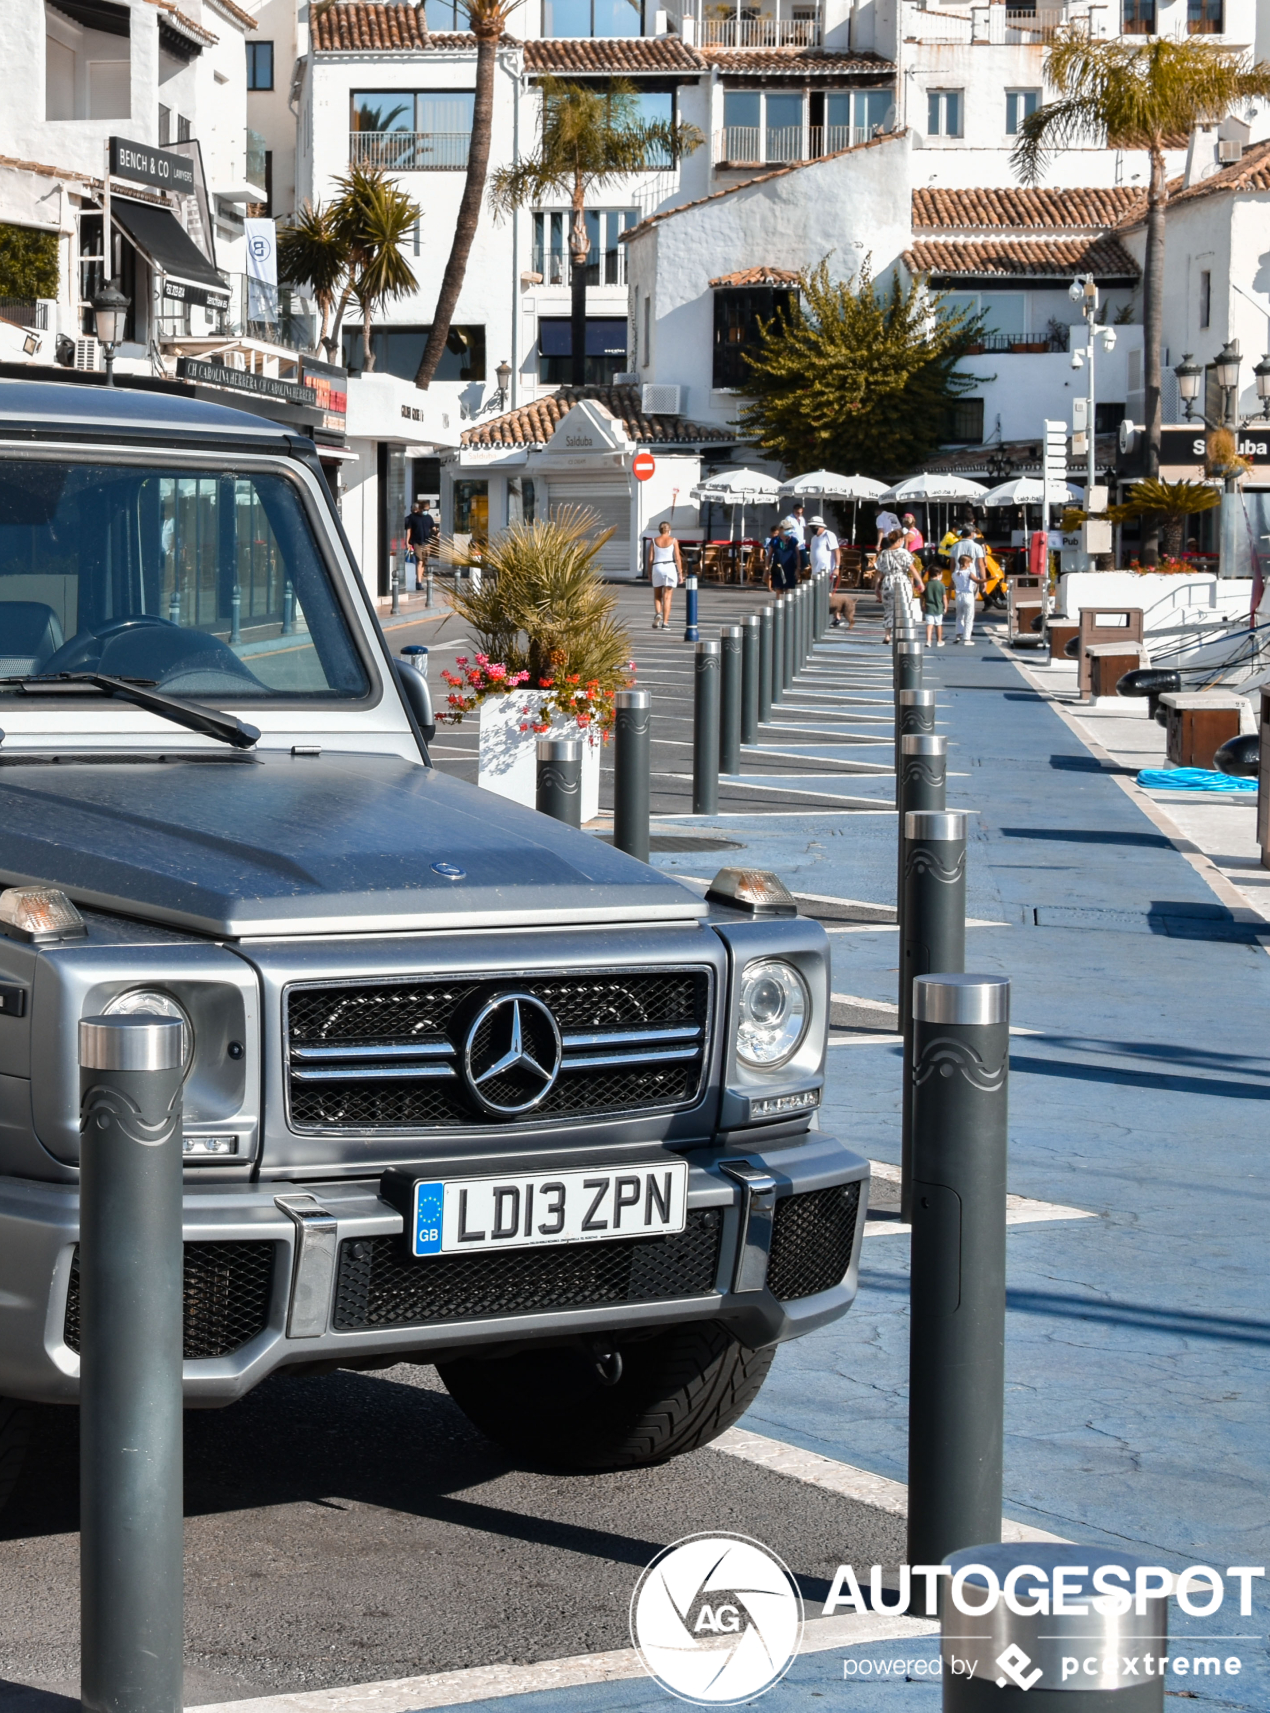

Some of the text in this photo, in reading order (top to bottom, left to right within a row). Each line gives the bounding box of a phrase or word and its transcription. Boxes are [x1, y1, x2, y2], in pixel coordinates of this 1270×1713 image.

[119, 148, 193, 183] BENCH & CO LAWYERS
[187, 362, 197, 376] CH
[198, 363, 230, 384] CAROLINA
[229, 371, 257, 391] HERRERA
[566, 436, 593, 447] Salduba
[1063, 537, 1079, 546] Pub
[457, 1172, 673, 1243] LD13 ZPN
[419, 1229, 438, 1242] GB
